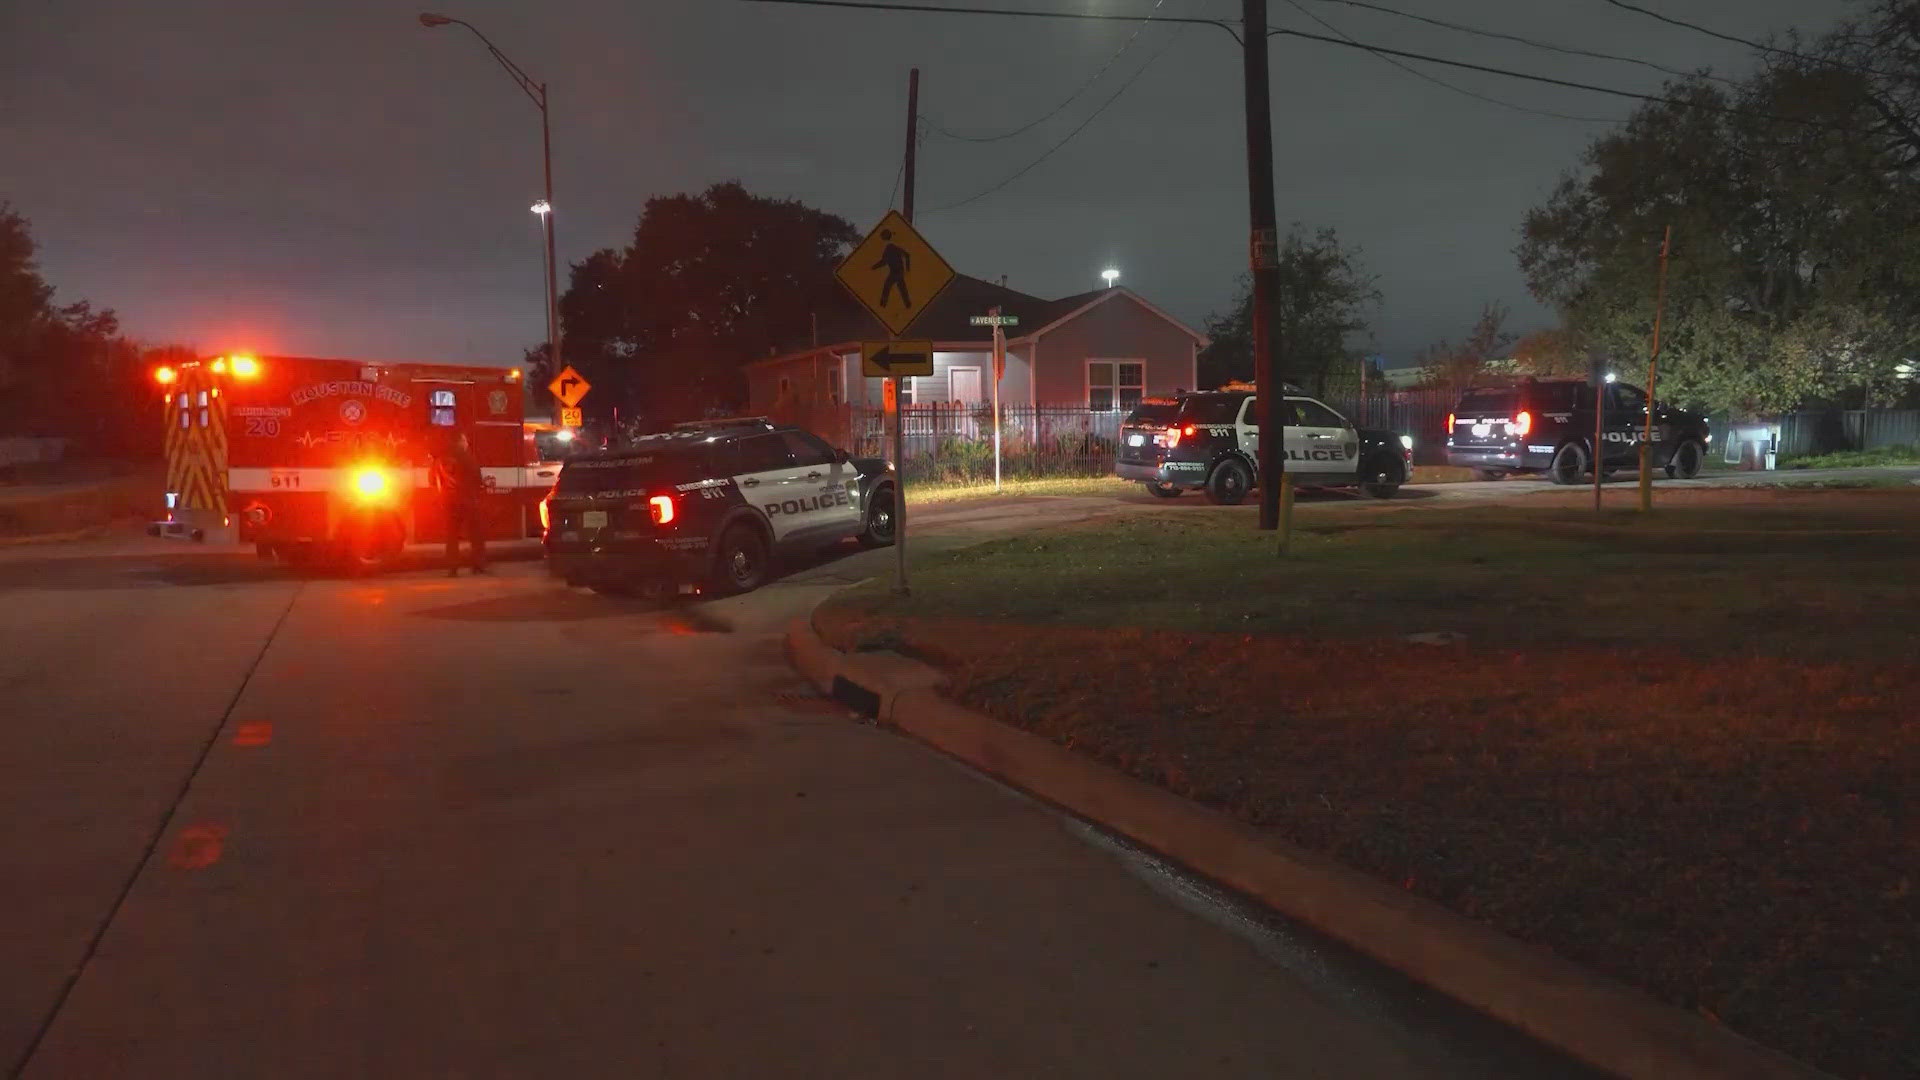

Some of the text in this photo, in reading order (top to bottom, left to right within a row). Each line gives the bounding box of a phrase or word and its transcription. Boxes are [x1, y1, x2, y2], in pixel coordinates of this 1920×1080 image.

[975, 316, 1002, 324] AVENUE
[1003, 316, 1008, 324] L
[292, 381, 411, 408] HOUSTON FIRE
[564, 411, 580, 419] 20
[245, 416, 280, 438] 20
[1209, 428, 1230, 438] 911
[271, 476, 301, 488] 911
[675, 478, 731, 492] EMERGENCY
[598, 488, 648, 499] POLICE
[700, 487, 726, 500] 911
[763, 491, 848, 519] POLICE
